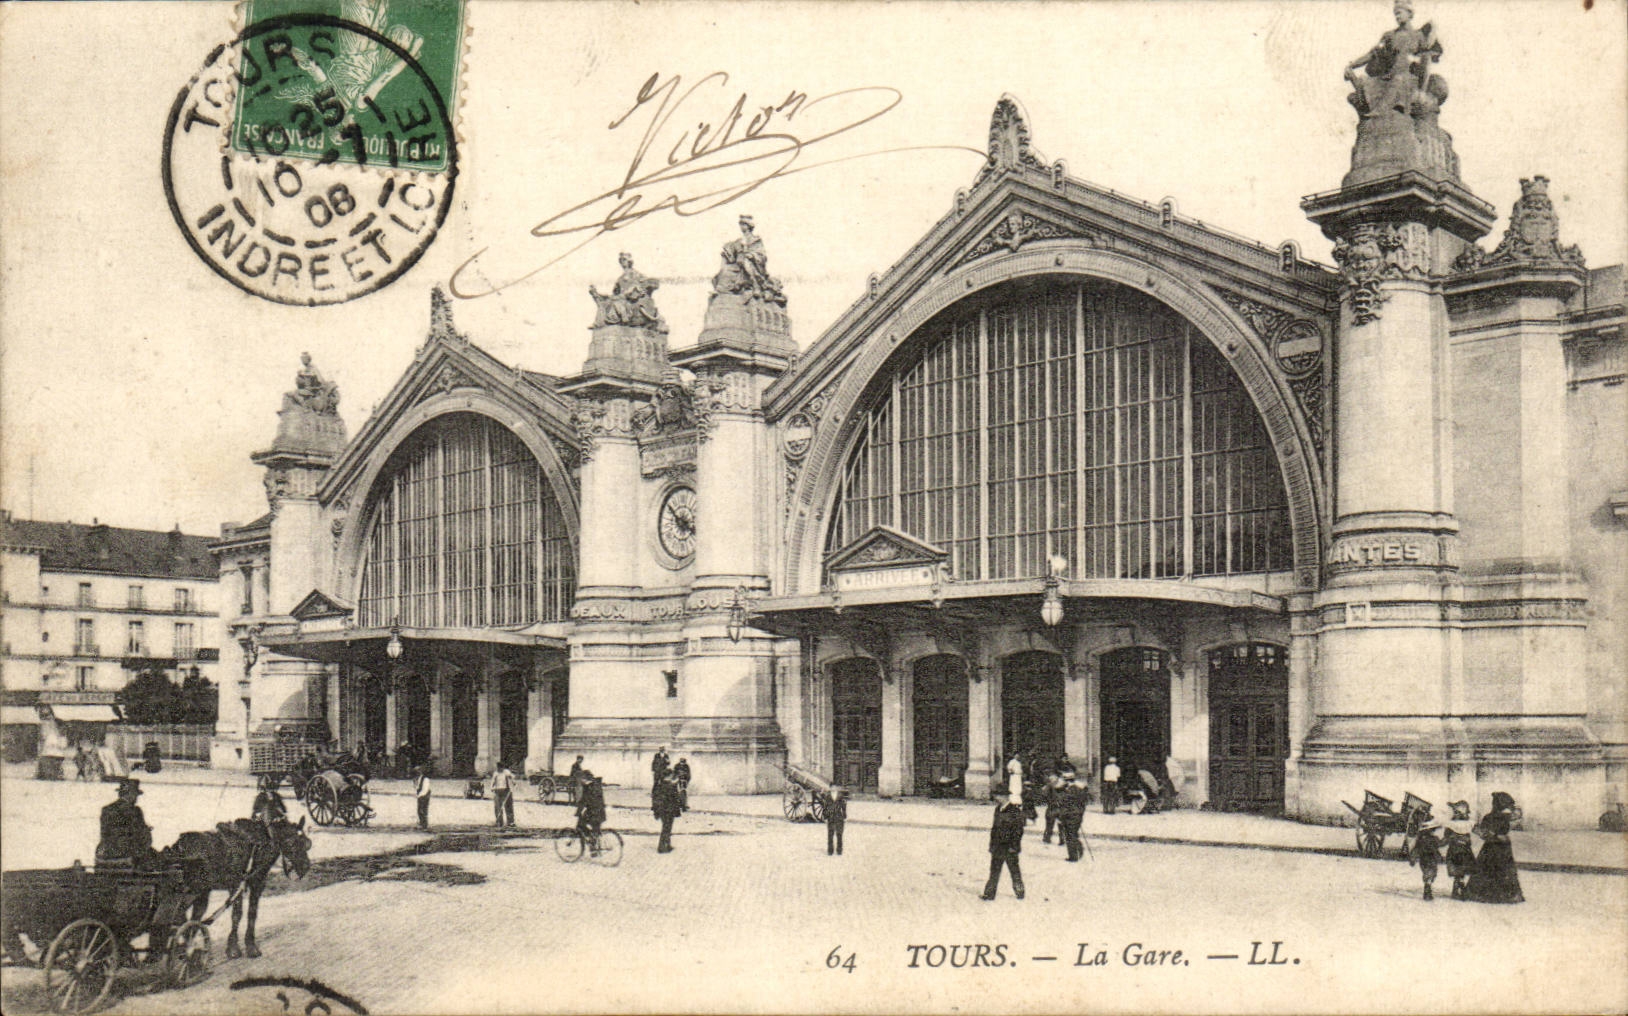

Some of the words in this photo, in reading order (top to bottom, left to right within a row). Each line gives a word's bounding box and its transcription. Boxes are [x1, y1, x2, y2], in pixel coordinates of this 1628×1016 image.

[183, 31, 336, 133] TOURS
[197, 203, 335, 291] INDRE
[341, 228, 392, 283] ET
[304, 182, 357, 228] 08
